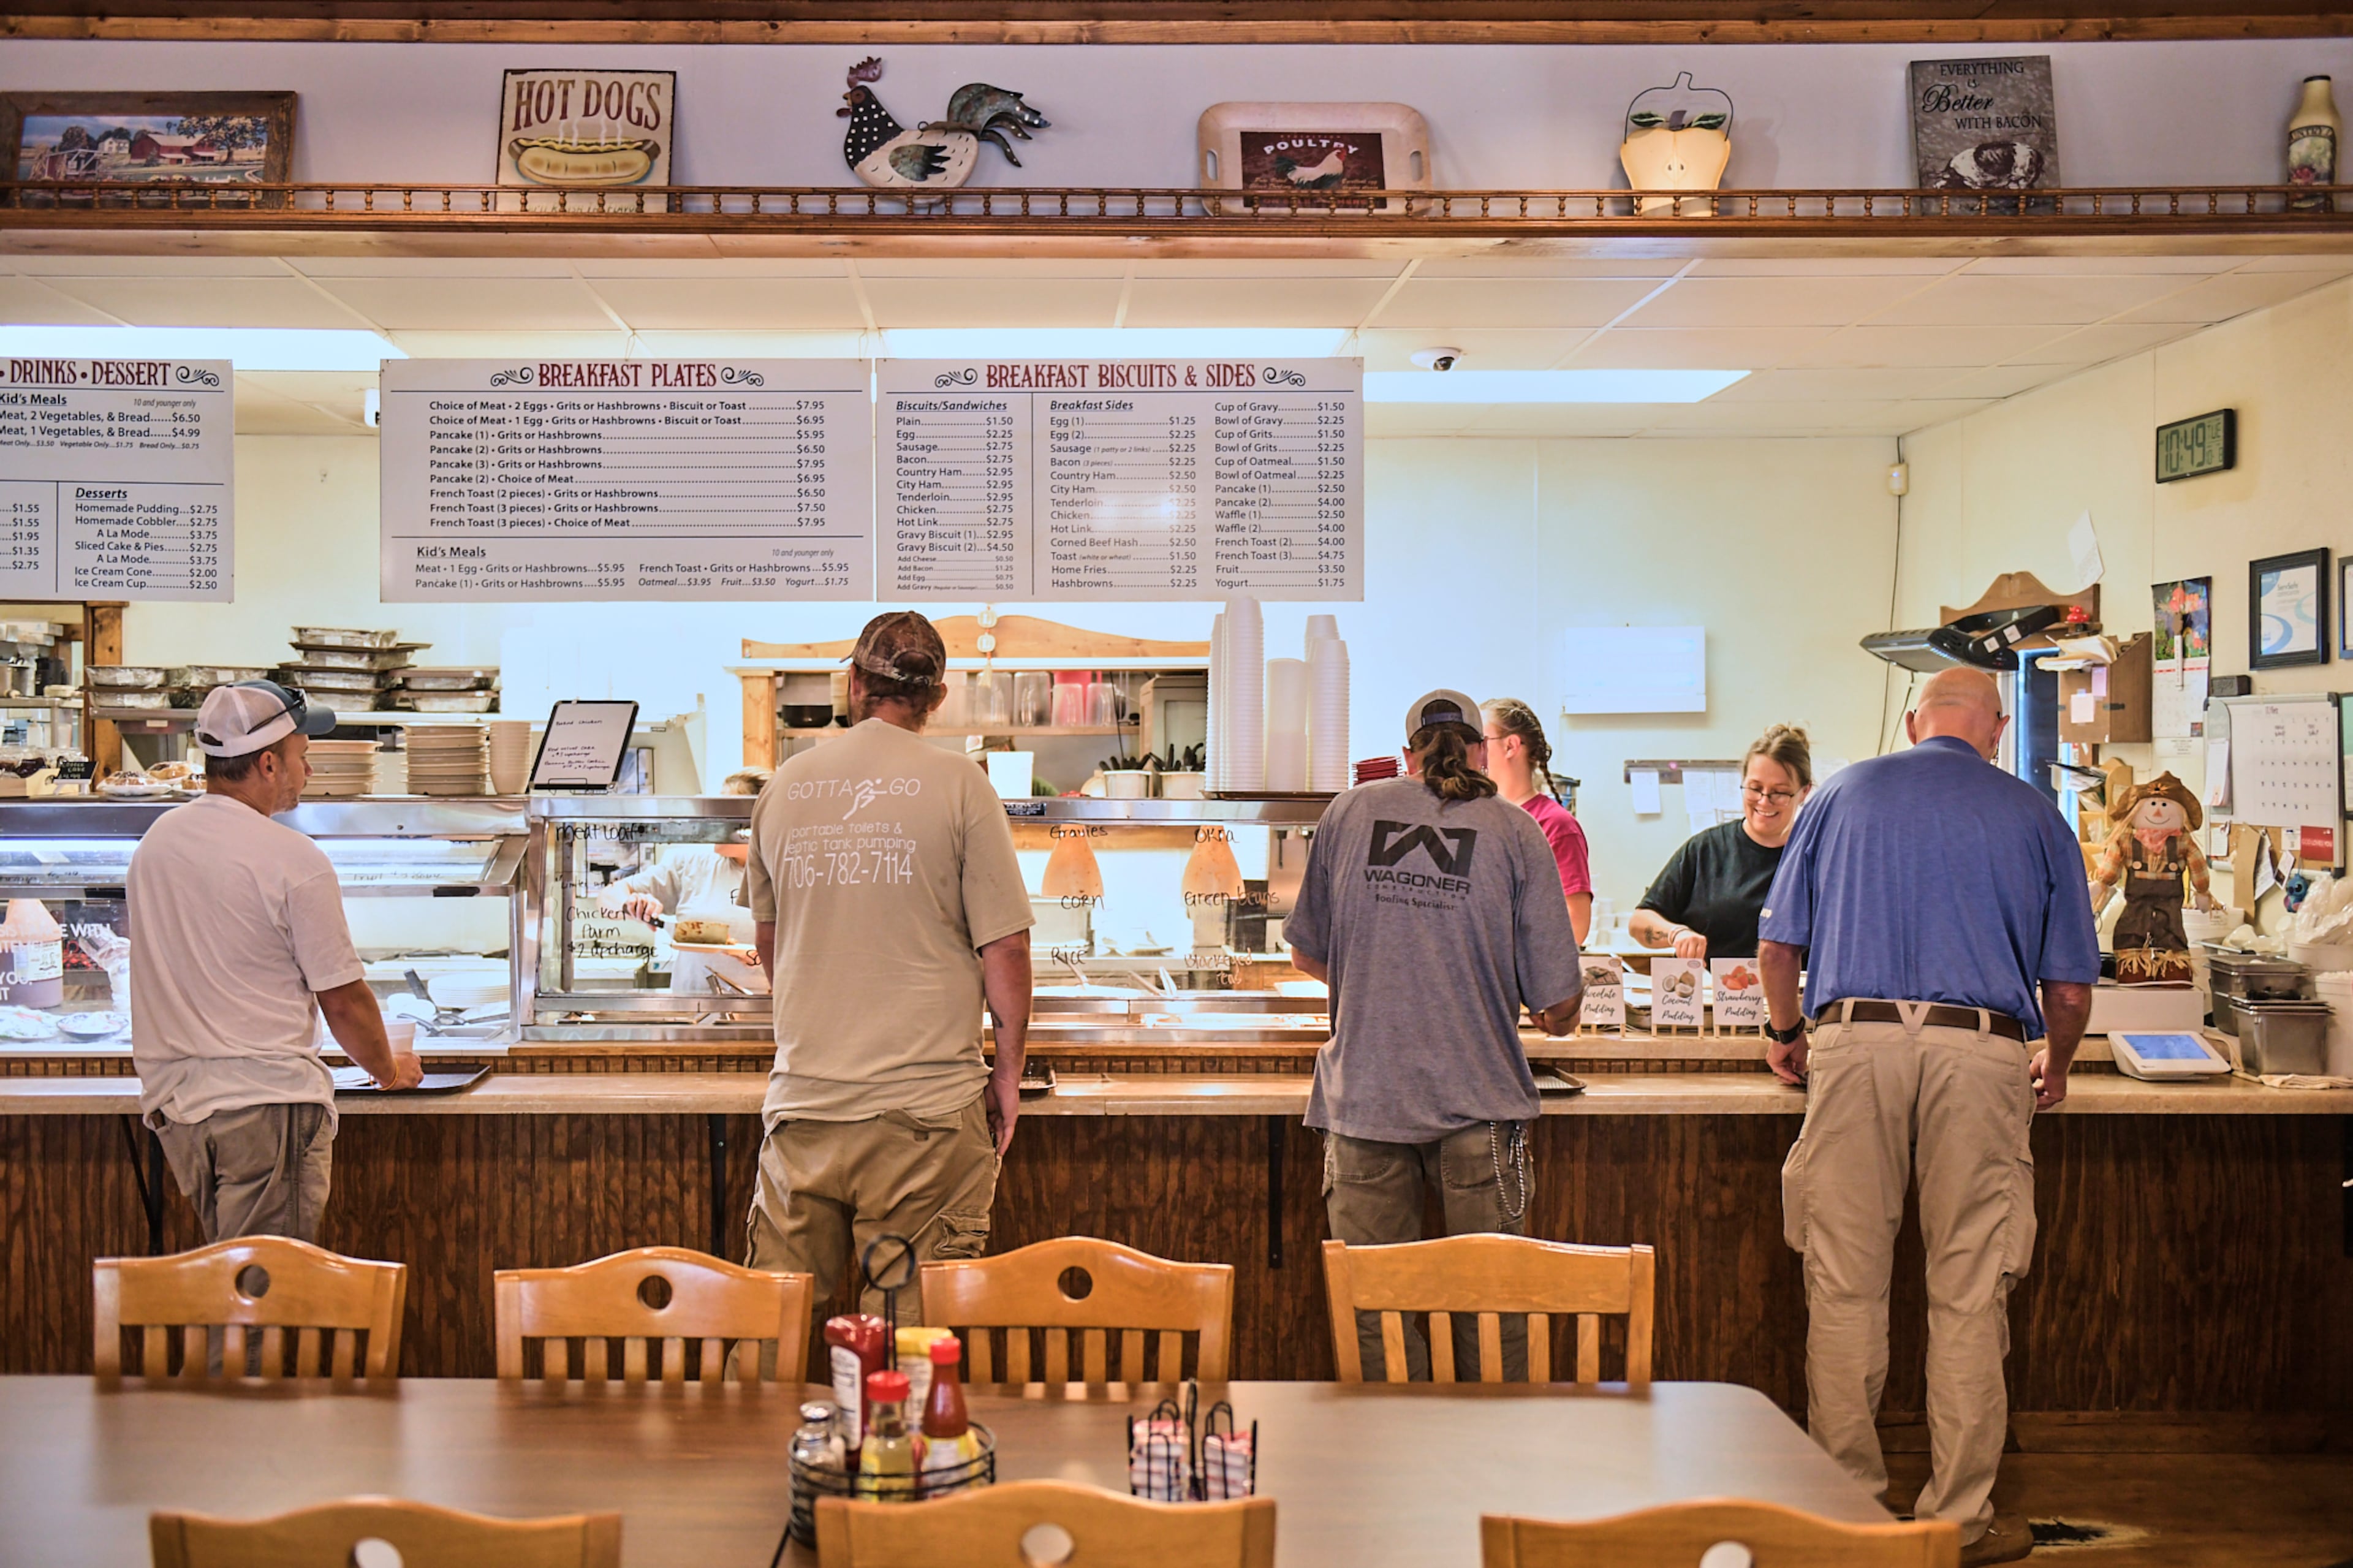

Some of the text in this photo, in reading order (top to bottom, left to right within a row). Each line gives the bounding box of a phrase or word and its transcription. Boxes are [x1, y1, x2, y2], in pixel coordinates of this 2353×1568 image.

[1940, 62, 2025, 75] EVERYTHING
[1922, 84, 1994, 113] Better
[512, 80, 661, 131] HOT DOGS
[1955, 115, 2042, 129] WITH BACON
[1263, 138, 1359, 154] POULTRY
[10, 360, 170, 385] DRINKS DESSERT
[539, 364, 716, 387] BREAKFAST PLATES
[987, 364, 1255, 387] BREAKFAST BISCUITS & SIDES
[0, 393, 66, 404] Kid's Meals
[183, 400, 196, 409] only
[430, 401, 464, 410] Choice
[524, 401, 547, 412] Eggs
[597, 401, 660, 410] Hashbrowns
[670, 401, 703, 410] Biscuit
[719, 401, 746, 410] Toast
[797, 400, 824, 410] $7.95
[896, 401, 1007, 410] Biscuits/Sandwiches
[1050, 400, 1133, 410] Breakfast Sides
[1215, 402, 1344, 413] Cup of Gravy $1.50
[31, 411, 36, 420] 2
[40, 411, 104, 423] Vegetables,
[107, 412, 115, 422] &
[119, 412, 150, 422] Bread
[172, 412, 200, 422] $6.50
[896, 417, 1013, 425] Plain $1.50
[476, 431, 488, 440] (1)
[797, 430, 824, 439] $5.95
[1050, 444, 1091, 455] Sausage
[1169, 444, 1195, 452] $2.25
[2165, 422, 2205, 473] 10:49
[896, 468, 936, 478] Country
[987, 467, 1013, 476] $2.95
[76, 488, 127, 498] Desserts
[897, 493, 1013, 501] Tenderloin $2.95
[13, 503, 39, 512] $1.55
[76, 504, 217, 515] Homemade Pudding $2.75
[13, 518, 39, 527] $1.55
[498, 519, 506, 528] (3
[510, 519, 545, 529] pieces)
[591, 518, 602, 526] of
[798, 517, 825, 527] $7.95
[897, 531, 926, 540] Gravy
[964, 530, 976, 539] (1)
[987, 530, 1013, 539] $2.95
[13, 547, 39, 555] $1.35
[75, 541, 104, 550] Sliced
[107, 542, 131, 550] Cake
[145, 542, 164, 551] Pies
[190, 543, 217, 552] $2.75
[12, 561, 39, 570] $2.75
[91, 578, 123, 587] Cream
[127, 579, 146, 589] Cup
[189, 580, 217, 589] $2.50
[786, 578, 814, 588] Yogurt
[787, 778, 920, 800] GOTTA GO
[792, 822, 902, 840] portable toilets &
[786, 837, 916, 854] eptic tank pumping
[784, 851, 912, 888] 706-782-7114
[1364, 869, 1471, 894] WAGONER
[1583, 1004, 1615, 1017] Pudding
[1724, 1007, 1758, 1020] Pudding
[1661, 1010, 1696, 1024] Pudding
